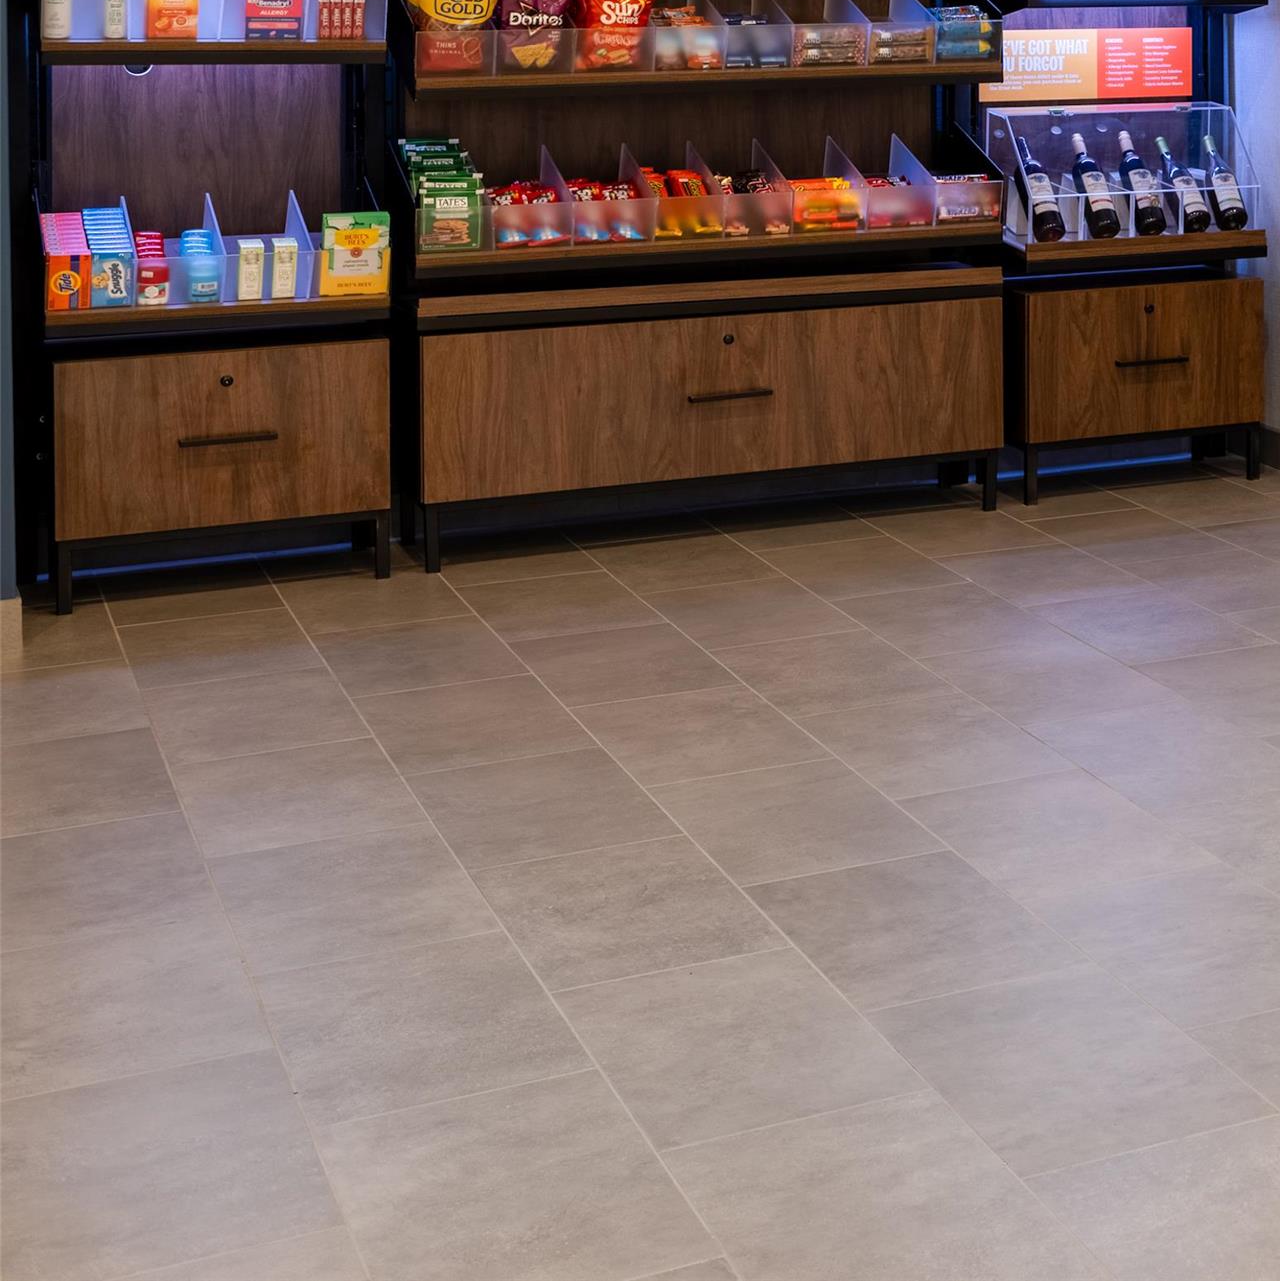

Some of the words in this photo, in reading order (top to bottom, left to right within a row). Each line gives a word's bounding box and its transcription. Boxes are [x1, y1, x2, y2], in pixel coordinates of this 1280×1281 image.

[258, 0, 290, 8] Benadryl
[441, 2, 485, 16] GOLD
[509, 12, 563, 27] Doritos
[600, 0, 641, 25] Sun
[616, 16, 639, 25] CHIPS
[1003, 39, 1025, 55] E'VE
[1028, 39, 1052, 55] GOT
[1055, 39, 1089, 54] WHAT
[1003, 56, 1014, 72] OU
[1018, 56, 1065, 72] FORGOT
[437, 198, 467, 207] TATE'S
[59, 273, 75, 294] Tide
[111, 262, 125, 295] Snuggle
